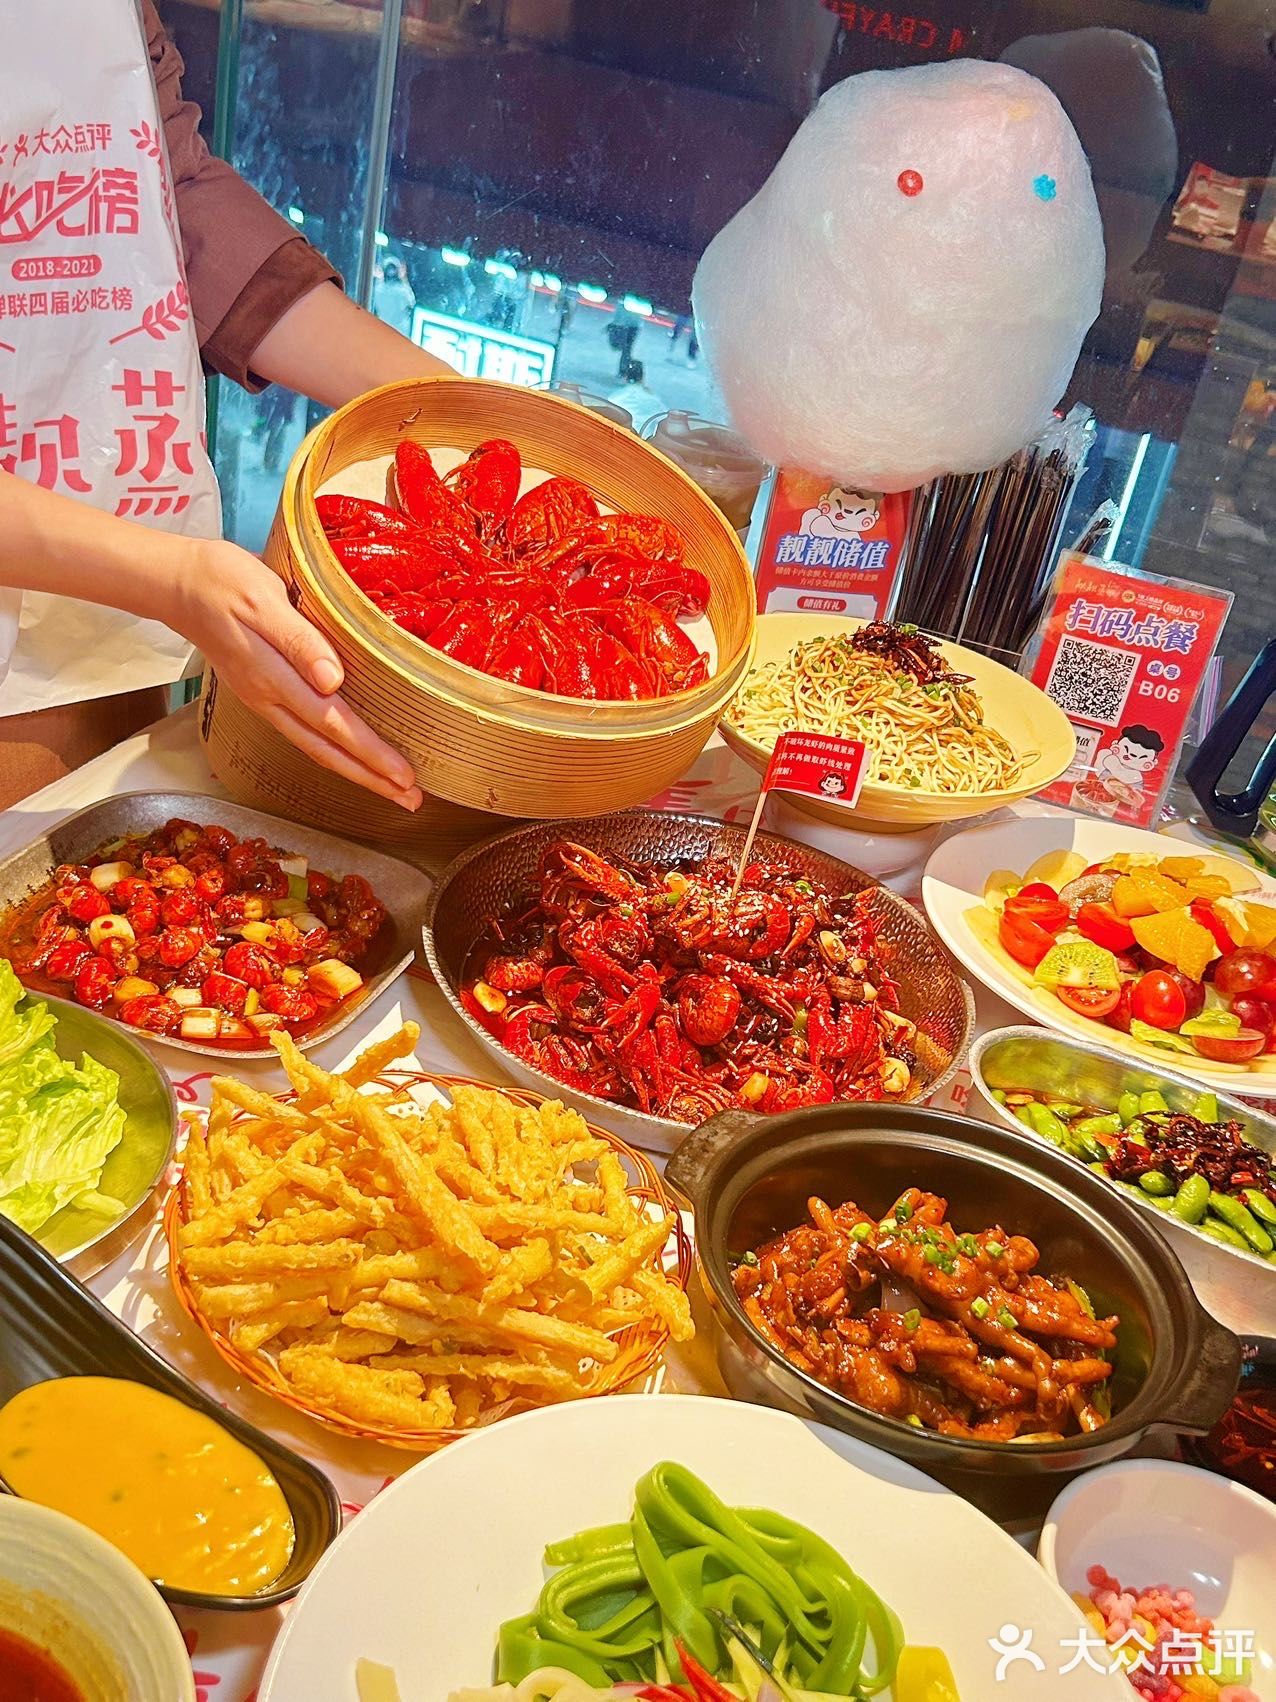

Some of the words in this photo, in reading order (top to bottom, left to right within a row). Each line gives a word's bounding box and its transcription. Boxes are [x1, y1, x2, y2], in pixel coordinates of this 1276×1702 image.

[32, 123, 112, 156] 大众点评
[19, 258, 96, 278] 2018-2021
[775, 534, 891, 569] 靓靓储值
[803, 598, 840, 611] 储值有礼
[1066, 598, 1199, 654] 扫码点餐
[1147, 660, 1181, 680] 桌号
[1138, 682, 1181, 703] B06
